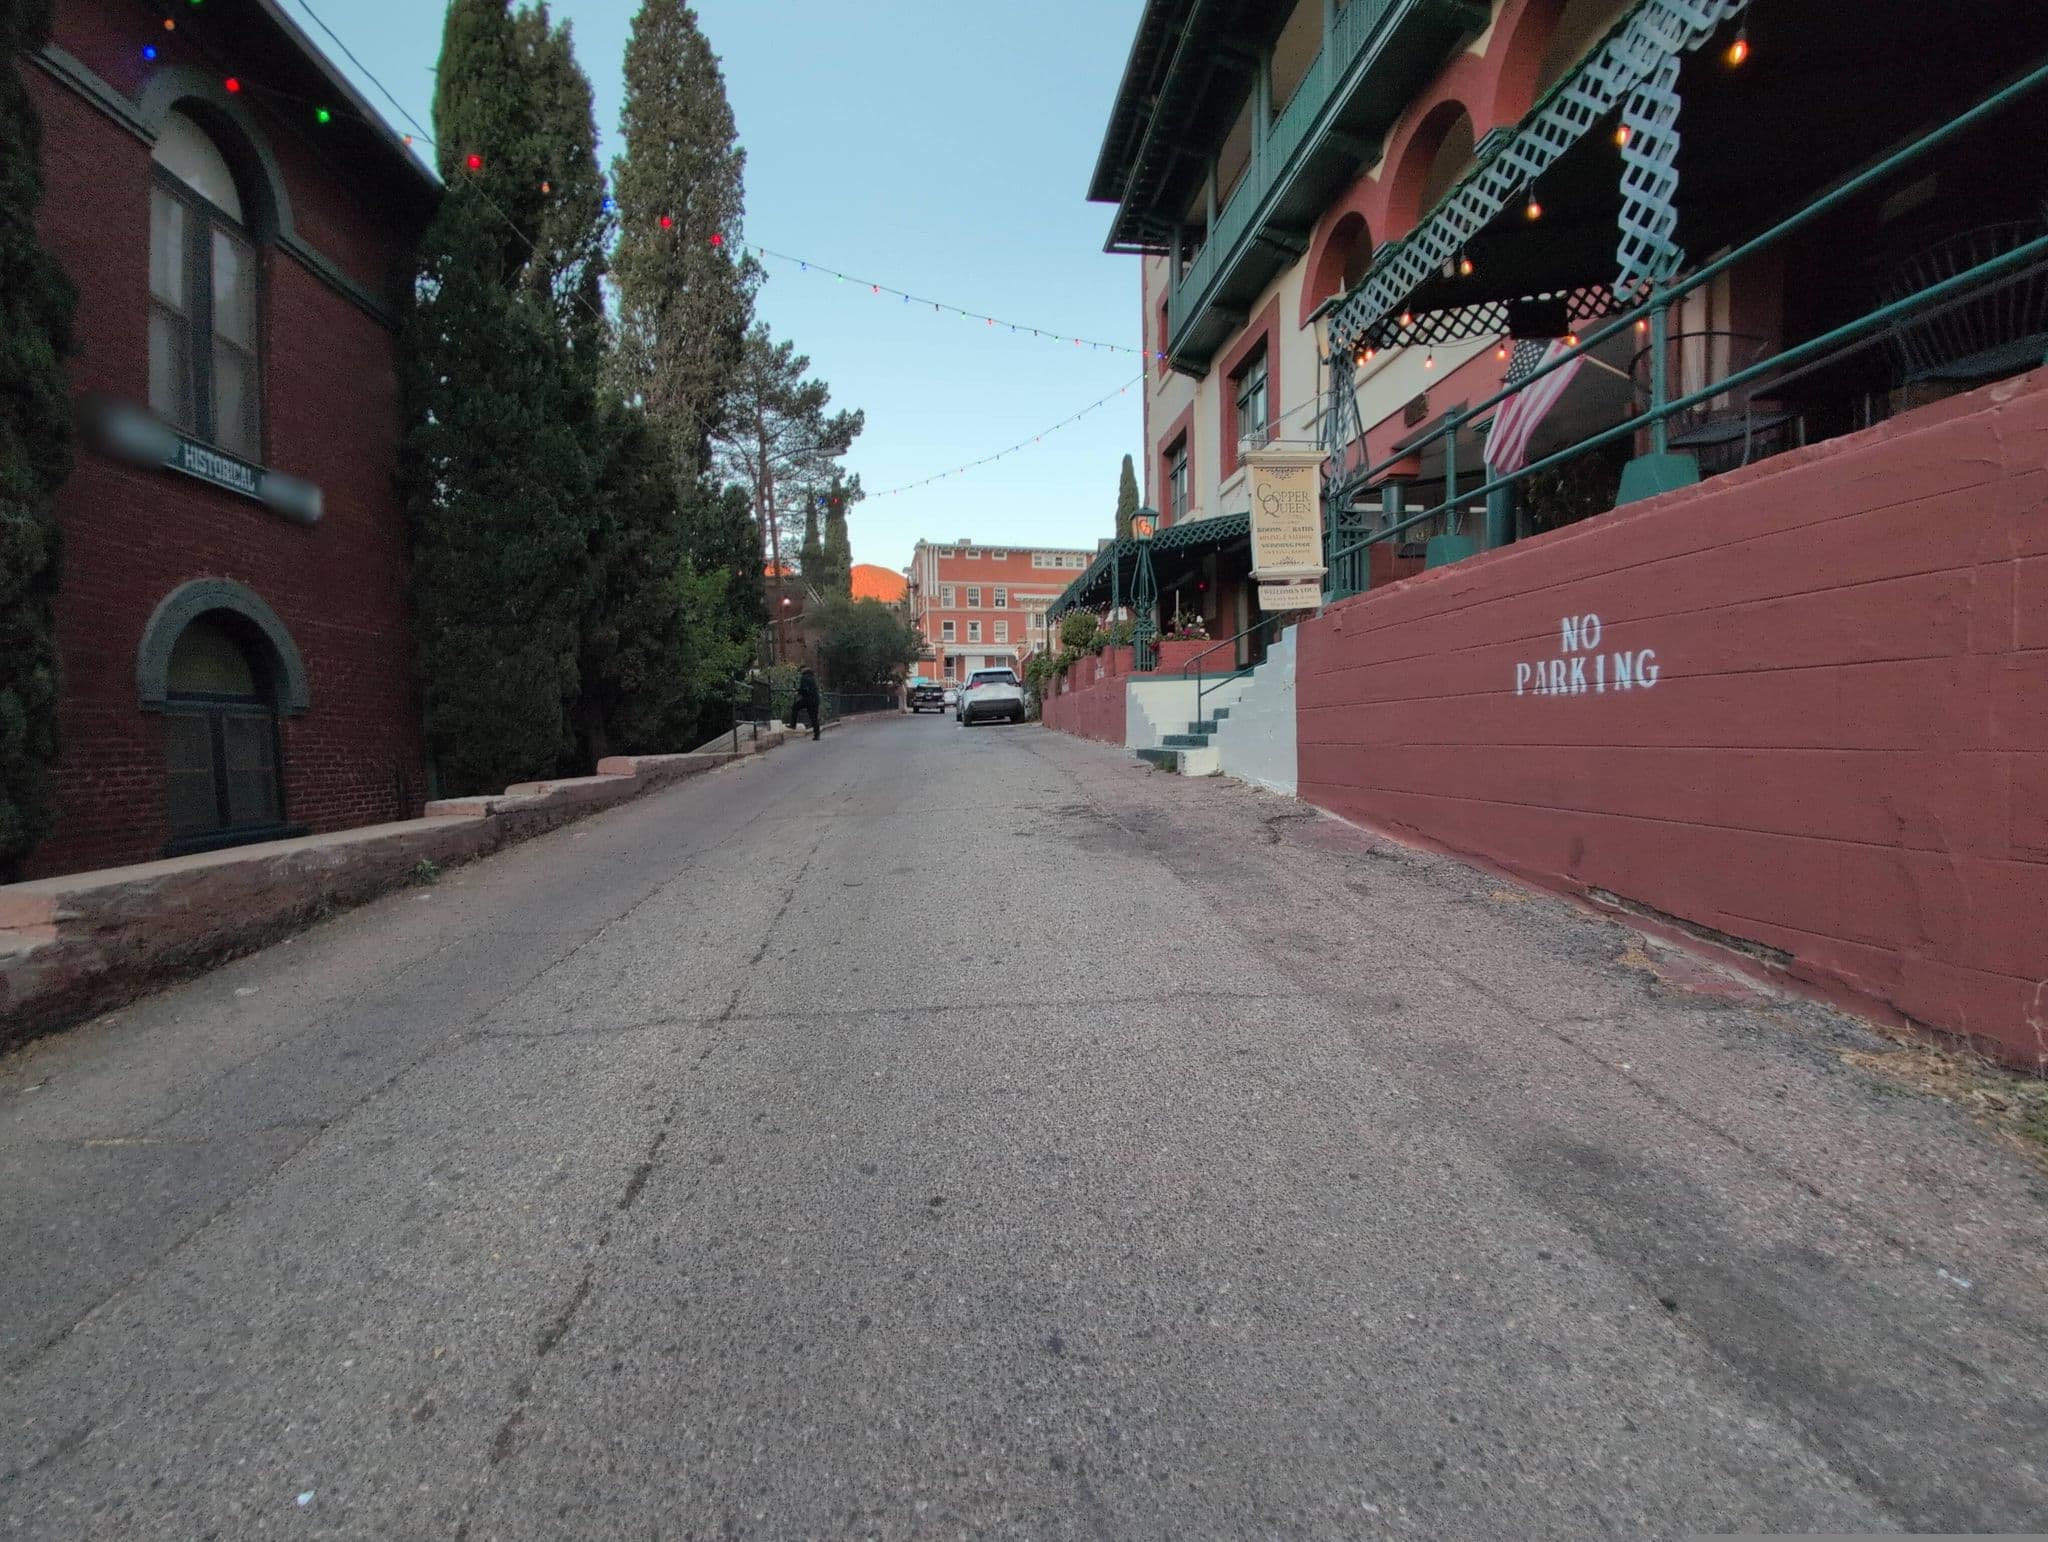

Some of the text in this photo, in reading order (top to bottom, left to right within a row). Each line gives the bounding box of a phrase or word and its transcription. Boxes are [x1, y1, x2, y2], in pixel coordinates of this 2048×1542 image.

[183, 443, 256, 492] HISTORICAL
[1256, 482, 1311, 502] COPPER
[1263, 495, 1311, 518] QUEEN
[1561, 613, 1601, 653] NO
[1515, 648, 1660, 696] PARKING
